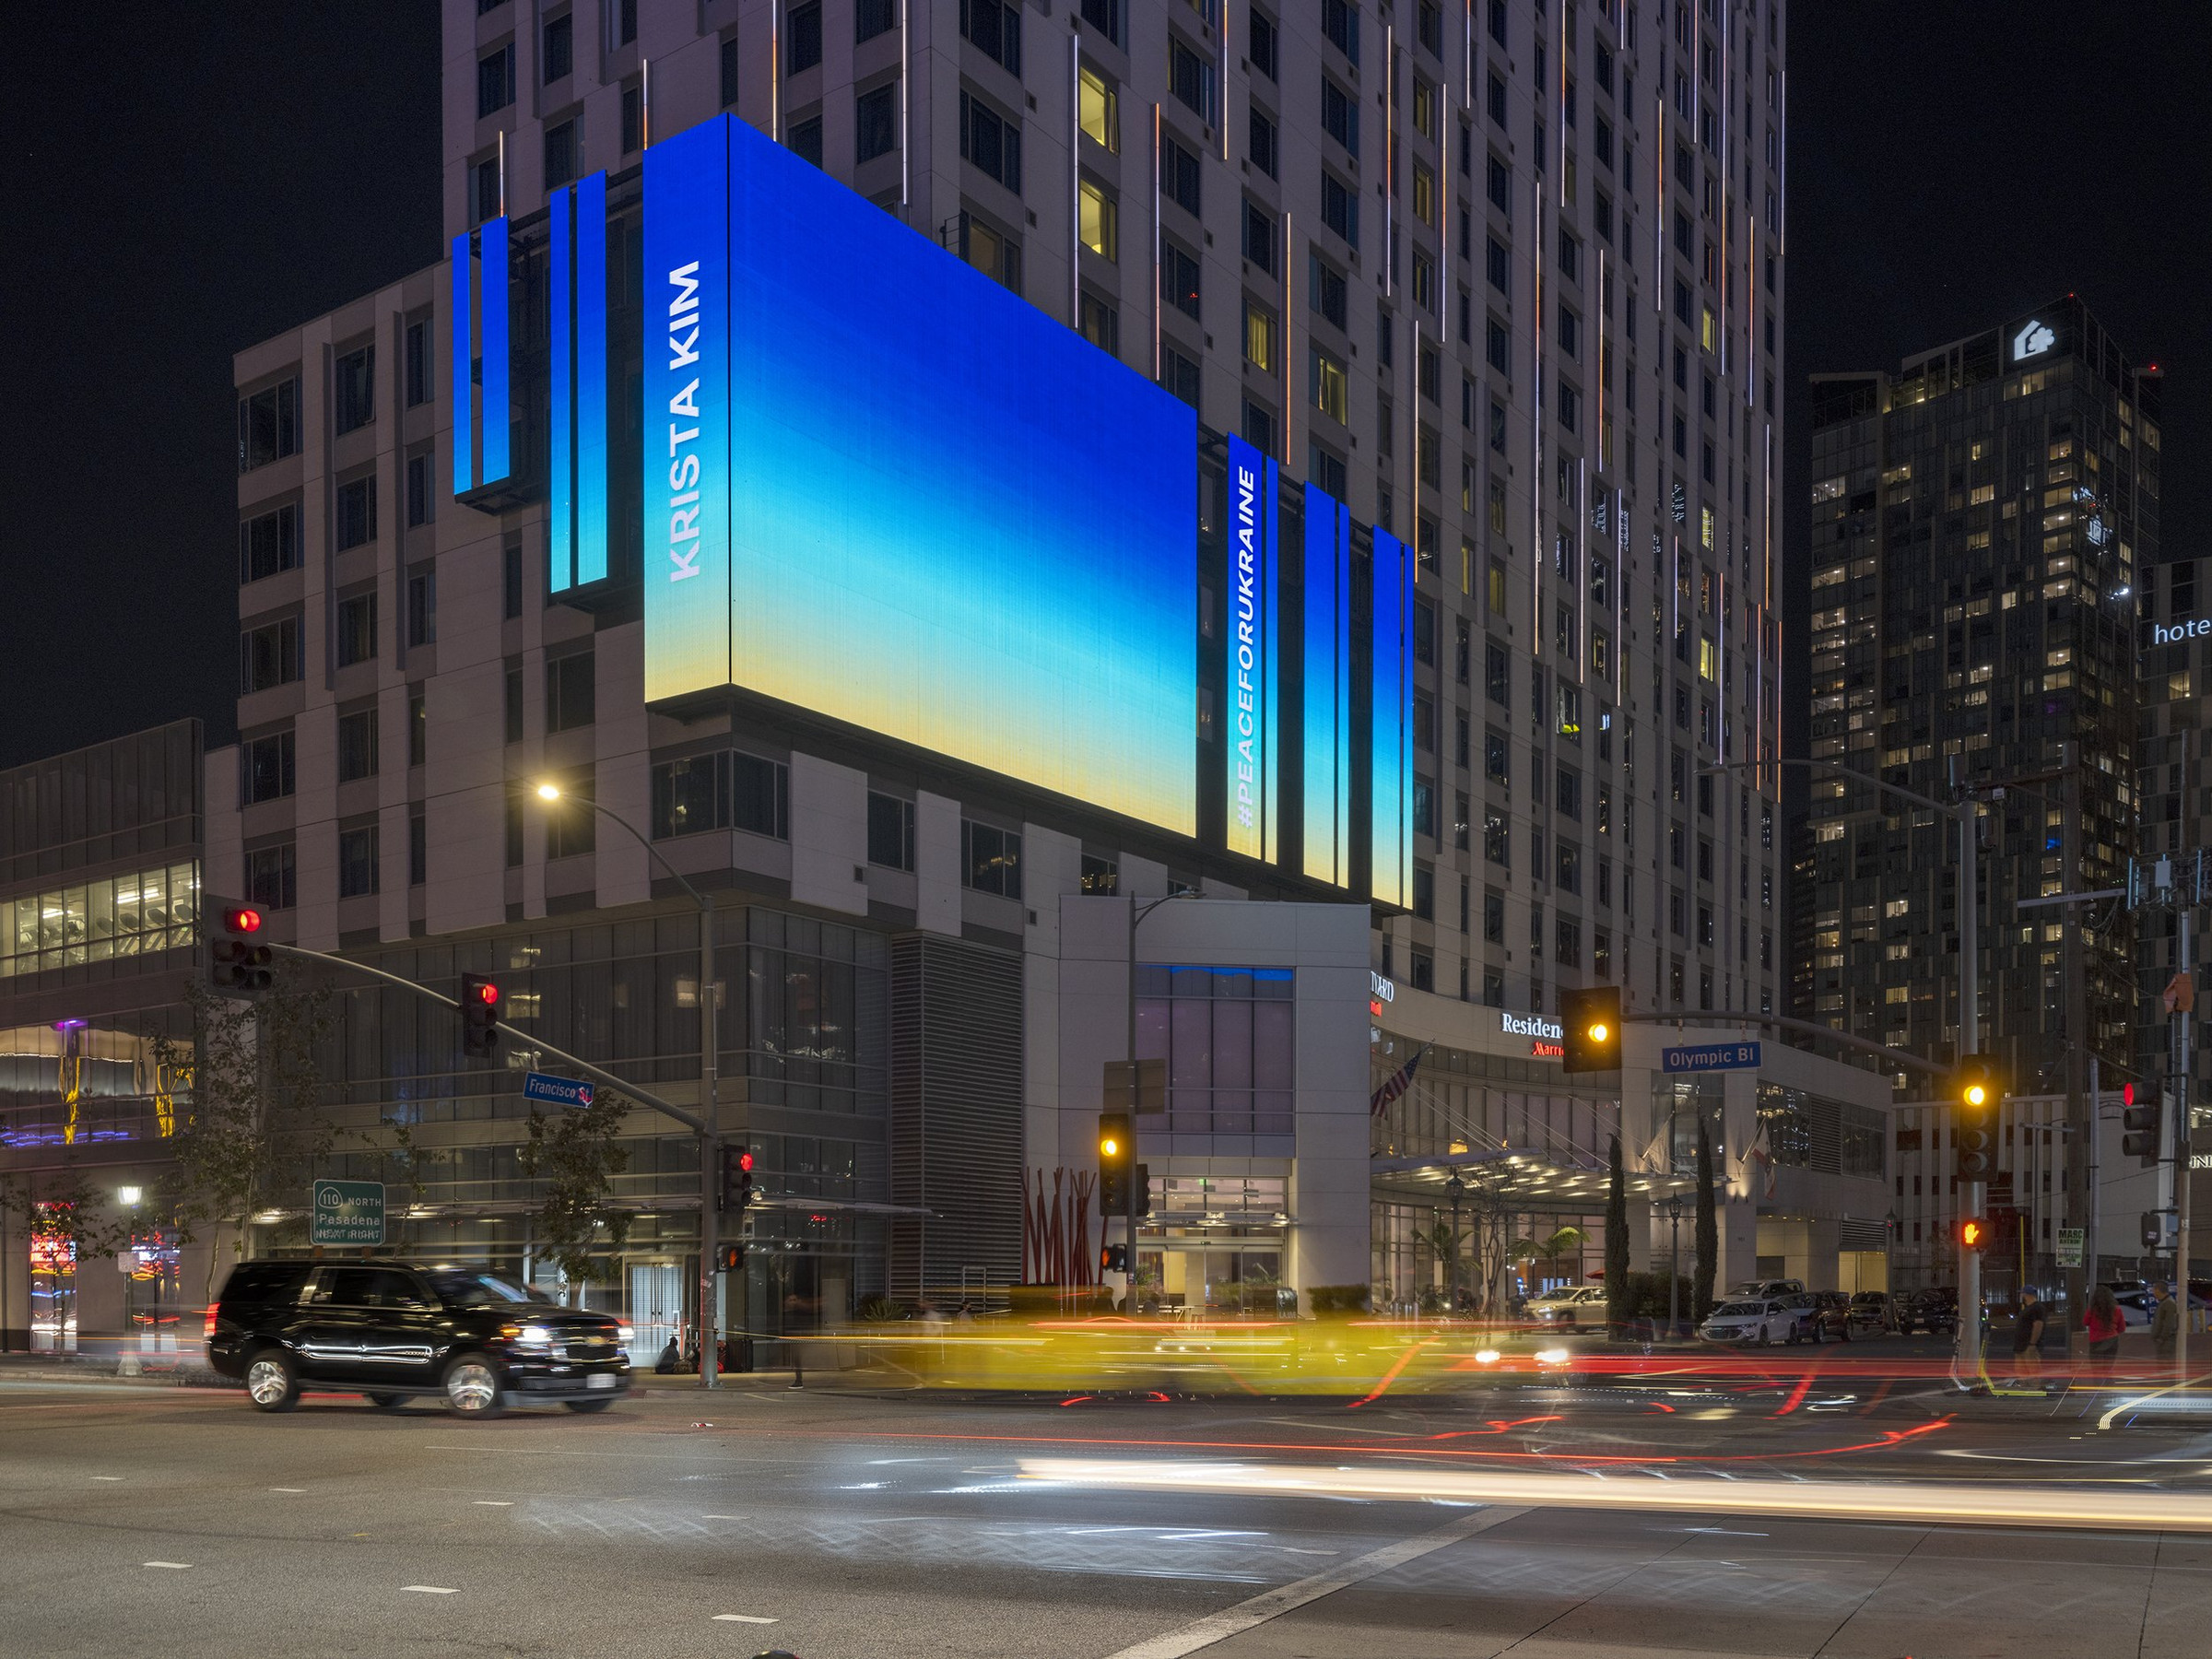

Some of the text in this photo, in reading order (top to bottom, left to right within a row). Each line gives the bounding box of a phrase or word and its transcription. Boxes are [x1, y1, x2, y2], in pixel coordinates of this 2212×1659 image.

[669, 260, 700, 582] KRISTA KIM
[2155, 619, 2211, 644] hote
[1238, 465, 1253, 829] #PEACEFORUKRAINE
[1502, 1013, 1563, 1039] Residen
[1670, 1047, 1754, 1069] Olympic Bl
[529, 1077, 576, 1099] Francisco
[323, 1194, 382, 1206] 110 NORTH
[319, 1213, 381, 1226] Pasadena
